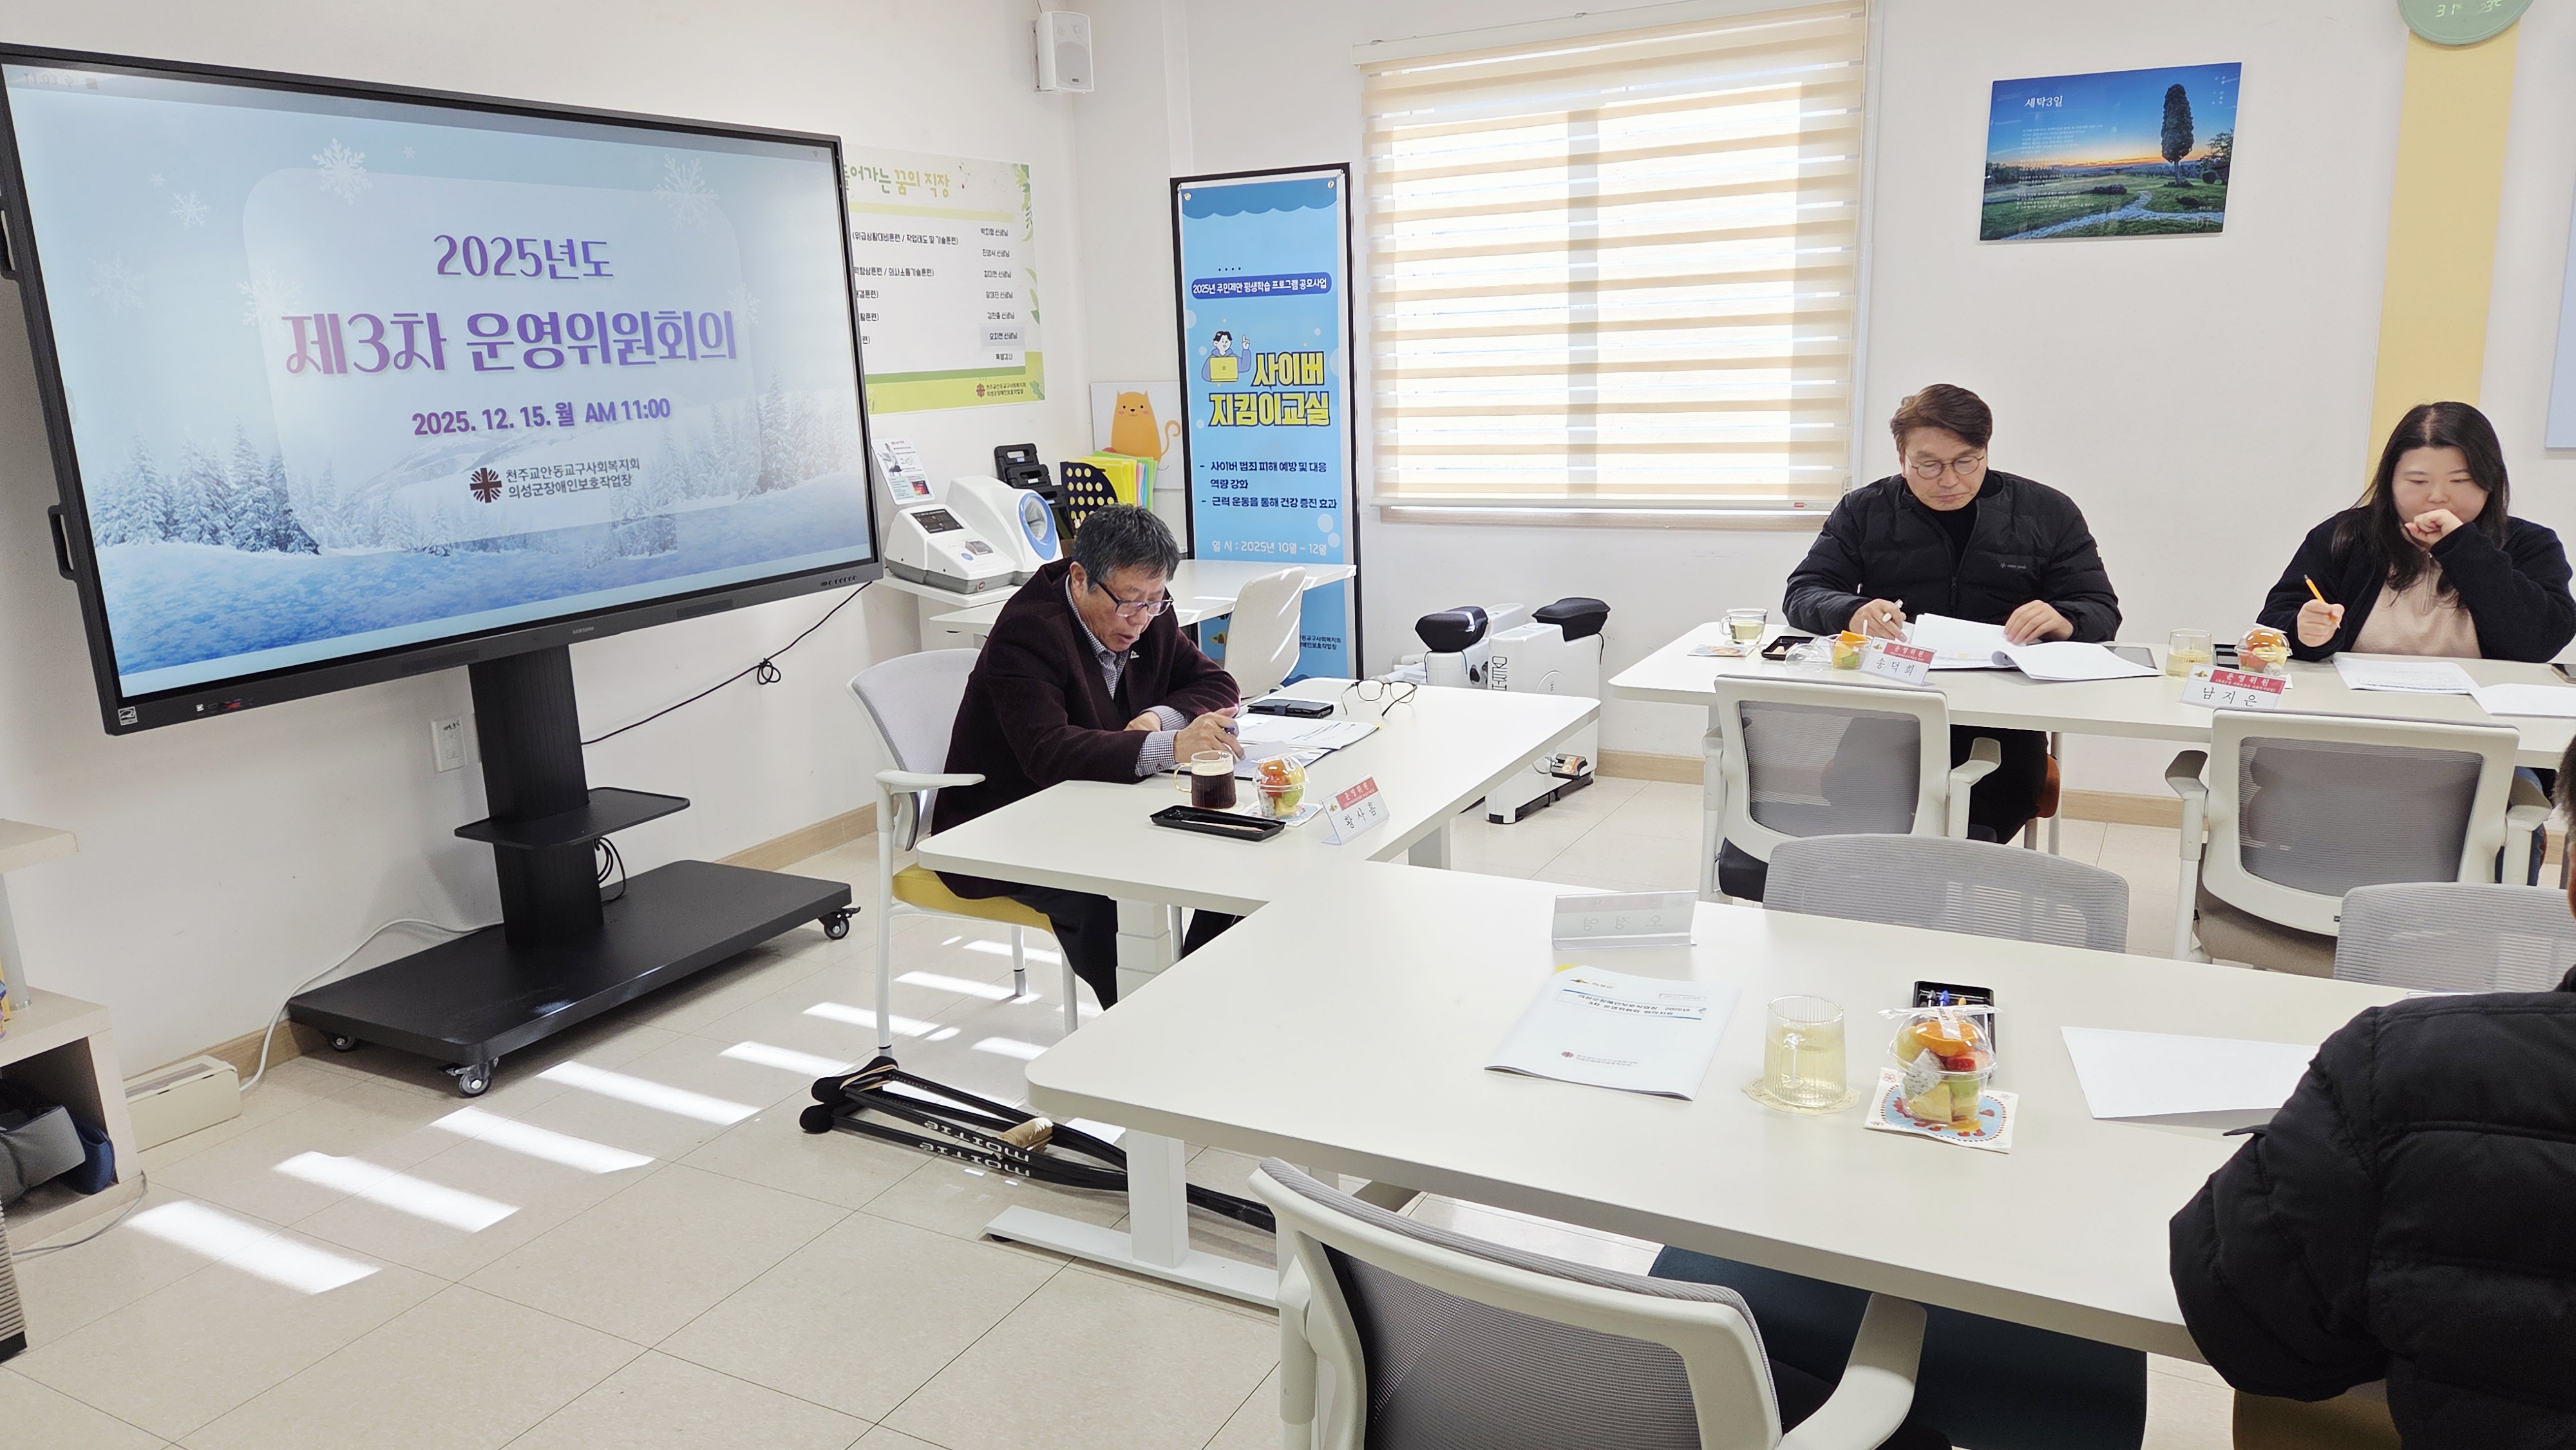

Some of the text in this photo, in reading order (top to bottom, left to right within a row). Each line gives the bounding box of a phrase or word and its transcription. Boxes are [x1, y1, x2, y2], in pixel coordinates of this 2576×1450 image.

[894, 169, 920, 196] 꿈의
[923, 173, 950, 198] 직장
[433, 234, 614, 279] 2025년도
[1193, 283, 1215, 294] 2025년
[1244, 281, 1271, 292] 평생학습
[1271, 279, 1298, 290] 프로그램
[1300, 278, 1327, 290] 공모사업
[281, 310, 738, 375] 제3차 운영위원회의
[1251, 351, 1325, 388] 사이버
[412, 397, 671, 436] 2025. 12. 15. 월 AM 11:00
[1208, 391, 1331, 428] 지킴이교실
[506, 458, 640, 483] 천주교안동교구사회복지회
[1211, 461, 1238, 471] 사이버
[1240, 461, 1257, 471] 범죄
[1259, 462, 1278, 472] 피해
[1279, 462, 1297, 472] 예방
[1299, 462, 1307, 472] 및
[1309, 462, 1327, 473] 대응
[508, 473, 633, 499] 의성군장애인보호작업장
[1210, 479, 1249, 489] 역량 강화
[1212, 496, 1230, 507] 근력
[1232, 496, 1258, 507] 운동을
[1260, 497, 1279, 507] 통해
[1280, 498, 1298, 508] 건강
[1300, 498, 1318, 509] 증진
[1319, 498, 1337, 509] 효과
[1240, 541, 1274, 554] 2025년
[1278, 542, 1297, 554] 10월
[1309, 543, 1327, 556] 12월
[2203, 686, 2258, 707] 남지은
